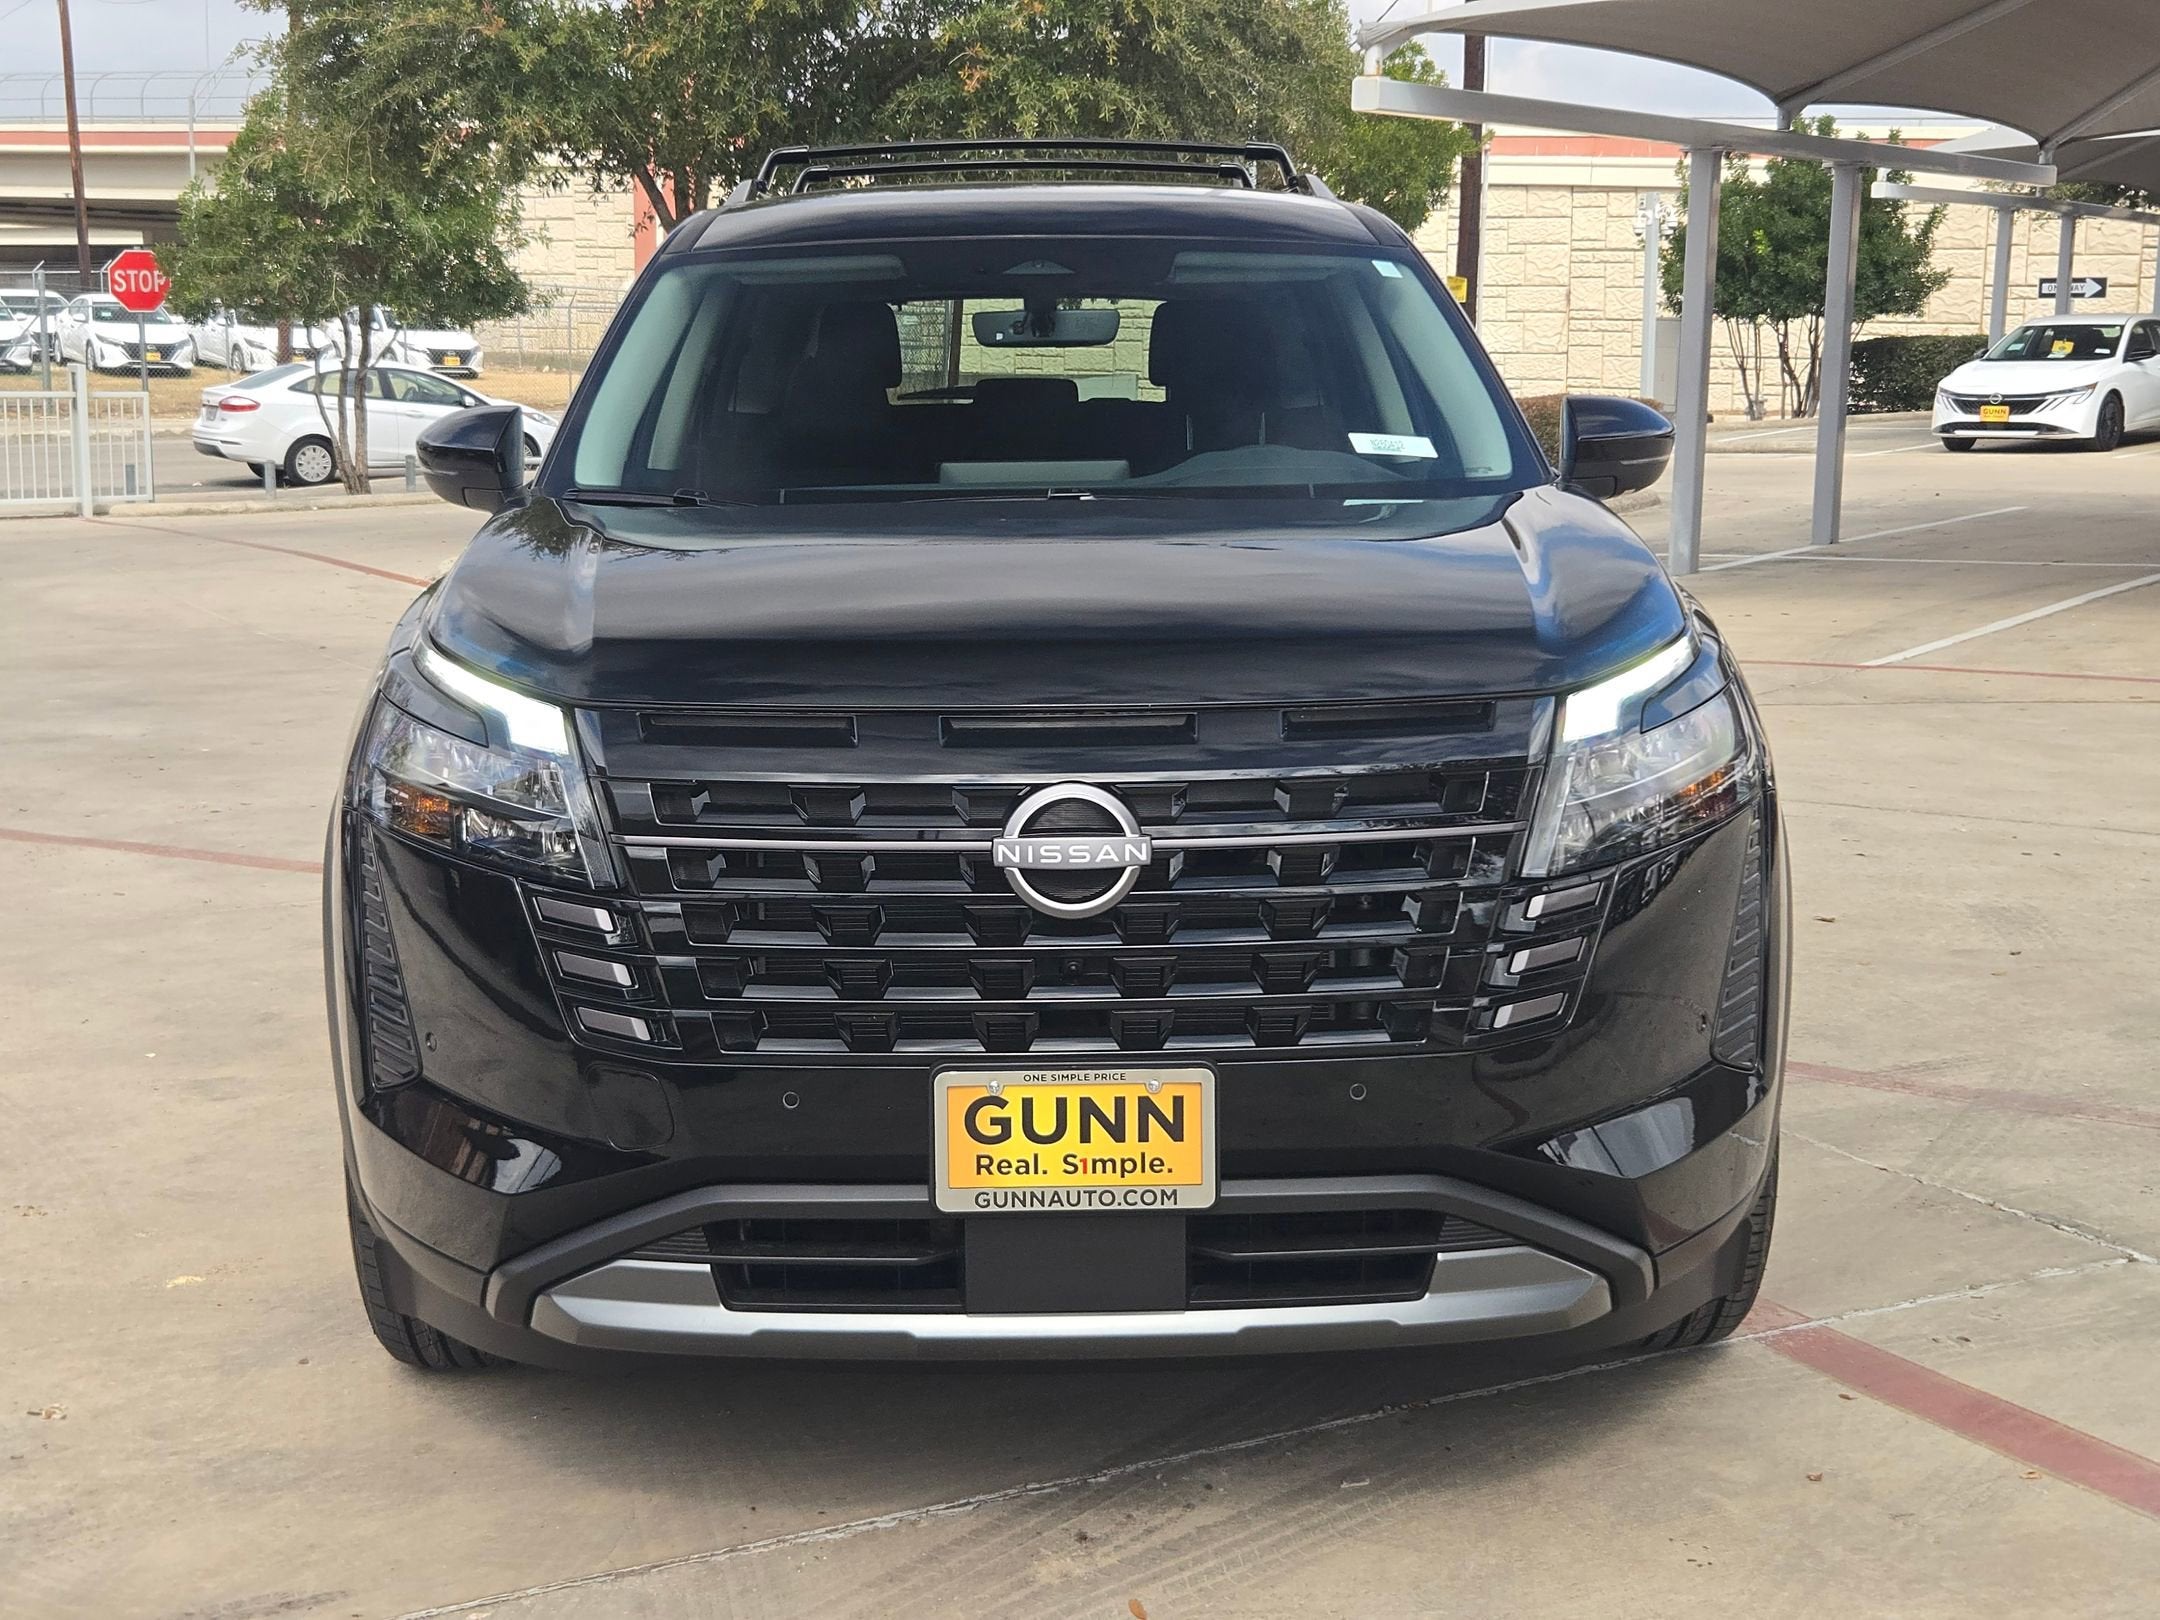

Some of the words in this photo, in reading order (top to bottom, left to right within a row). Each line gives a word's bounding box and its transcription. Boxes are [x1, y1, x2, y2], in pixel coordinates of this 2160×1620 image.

[114, 270, 166, 293] STOP
[997, 843, 1147, 863] NISSAN
[1023, 1073, 1047, 1082] ONE
[1050, 1073, 1090, 1082] SIMPLE
[1094, 1072, 1126, 1081] PRICE
[963, 1095, 1184, 1145] GUNN
[975, 1153, 1048, 1176] Real.
[974, 1188, 1178, 1209] GUNNAUTO.COM
